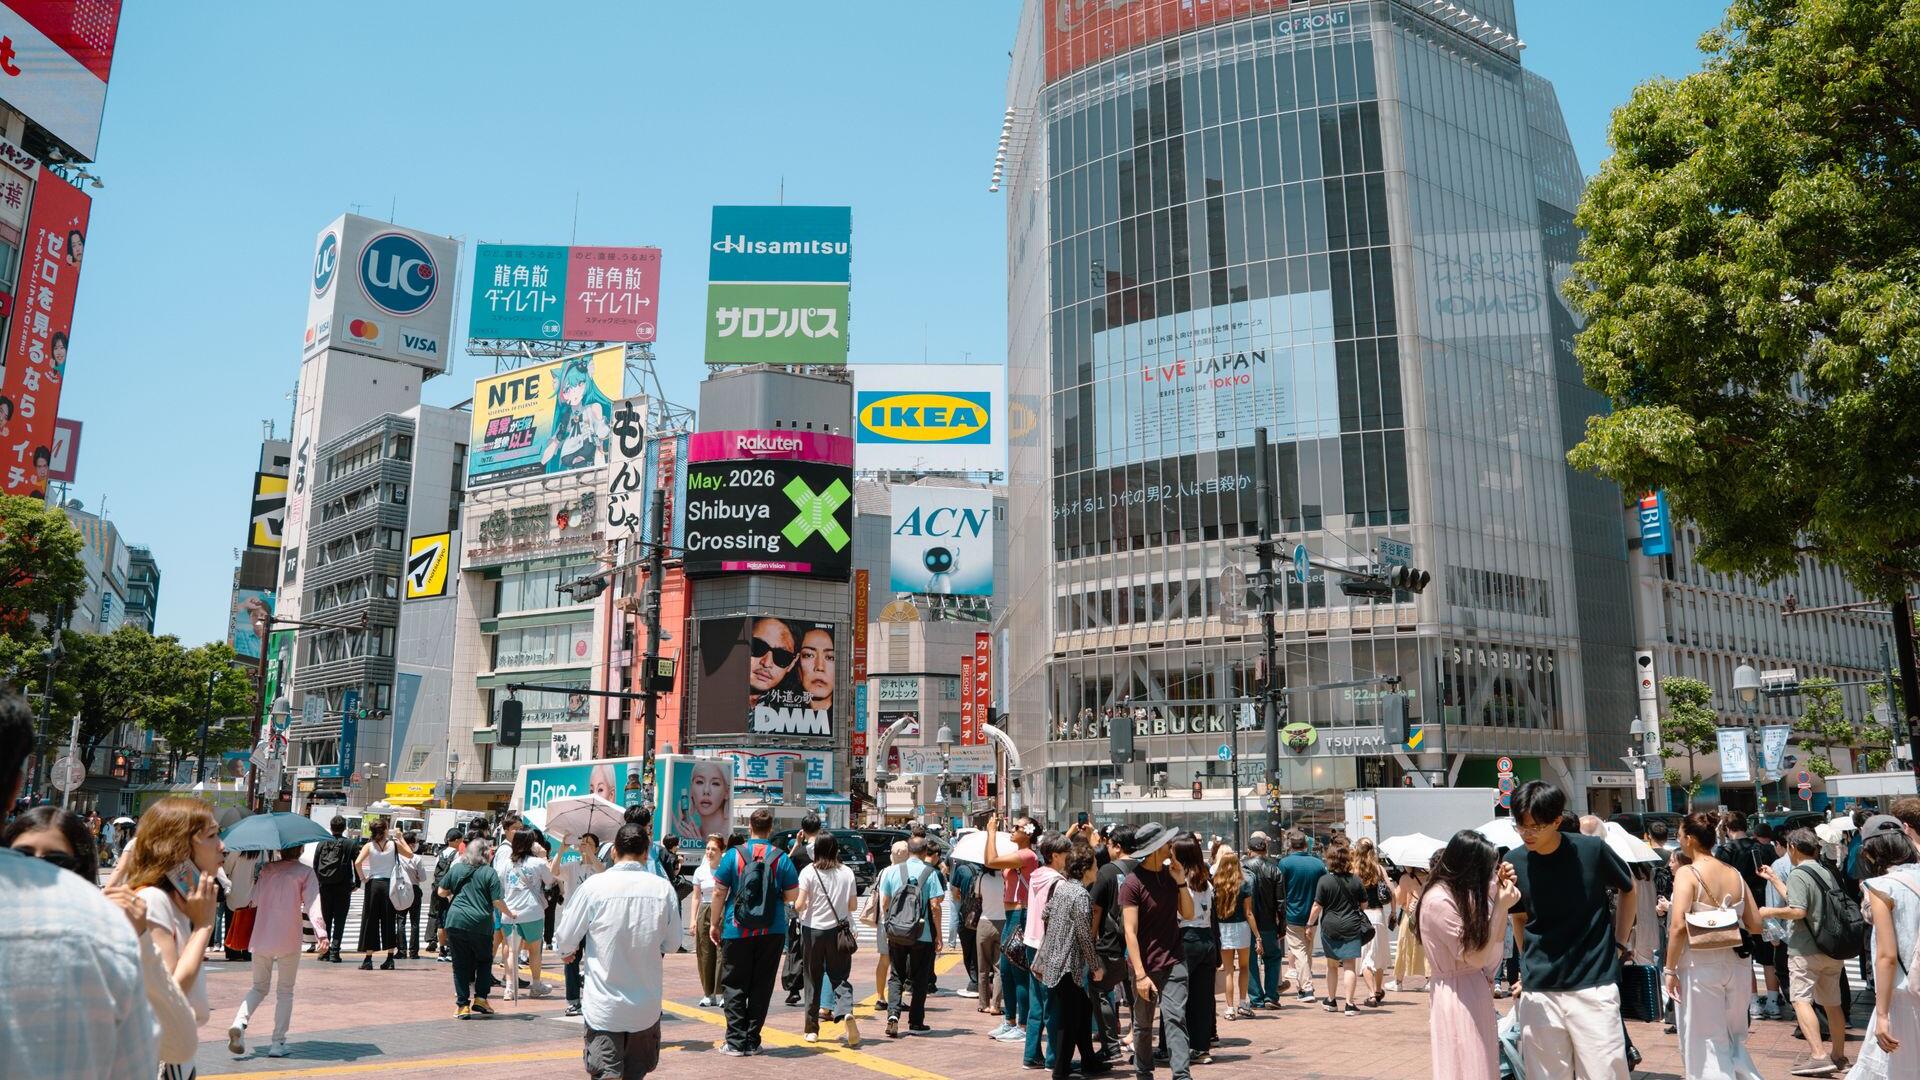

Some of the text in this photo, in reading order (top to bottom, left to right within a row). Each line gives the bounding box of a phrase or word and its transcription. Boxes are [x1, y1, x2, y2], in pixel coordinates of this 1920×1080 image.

[1279, 11, 1345, 36] QFRONT
[713, 235, 847, 254] Hisamitsu
[368, 249, 430, 296] UC
[494, 264, 549, 287] 龍角散
[587, 266, 642, 290] 龍角散
[484, 290, 557, 312] ダイレクト
[578, 291, 650, 315] ダイレクト
[716, 307, 839, 338] サロンパス
[403, 334, 437, 353] VISA
[1144, 348, 1266, 382] LIVE JAPAN
[488, 374, 540, 409] NTE
[1209, 374, 1250, 389] TOKYO
[871, 407, 979, 427] IKEA
[737, 436, 803, 451] Rakuten
[608, 401, 644, 533] もんじゃ
[688, 500, 770, 521] Shibuya
[894, 506, 991, 538] ACN
[687, 530, 780, 553] Crossing
[287, 557, 297, 573] 7F
[769, 562, 786, 570] Vision
[977, 640, 988, 697] カラオケ
[881, 690, 918, 699] クリニック
[754, 702, 831, 735] DMM
[962, 701, 972, 746] カラオ
